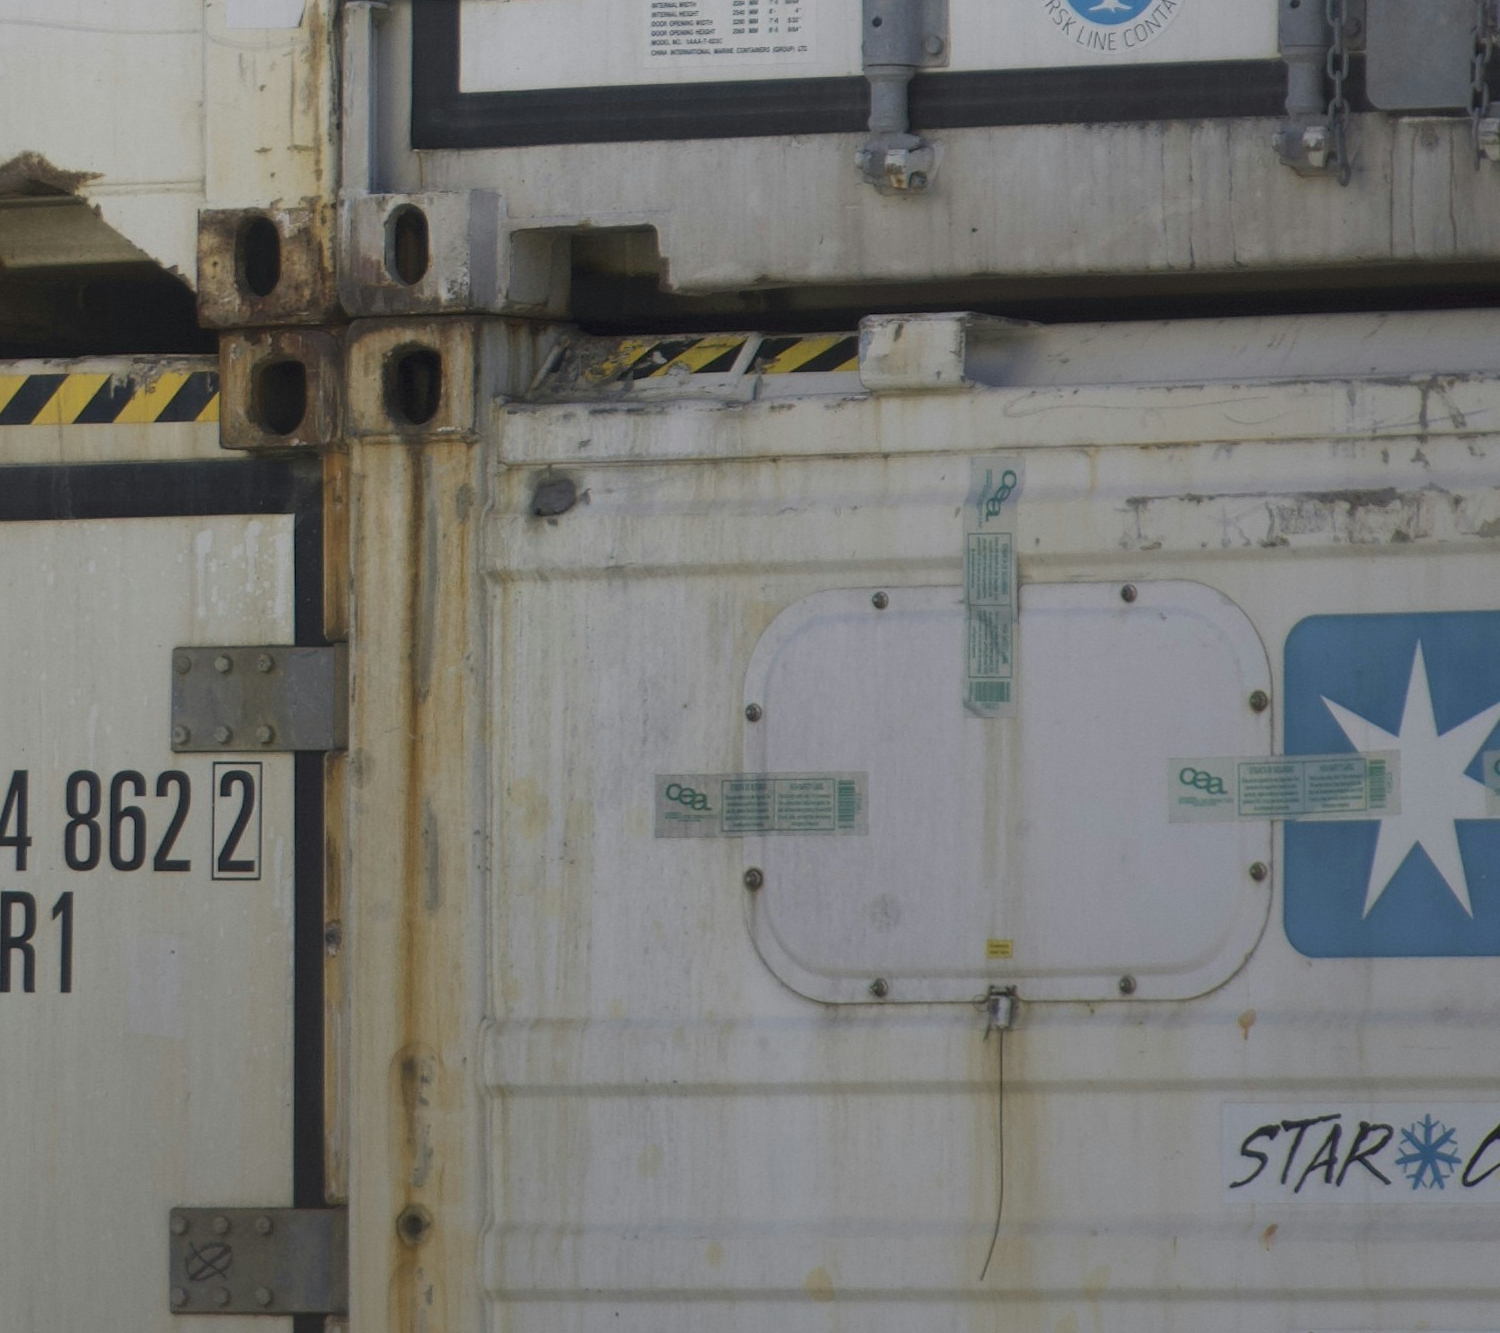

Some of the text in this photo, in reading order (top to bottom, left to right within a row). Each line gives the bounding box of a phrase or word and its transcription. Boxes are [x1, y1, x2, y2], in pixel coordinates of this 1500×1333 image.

[1076, 26, 1117, 51] LINE
[64, 767, 192, 873] 862
[219, 767, 258, 872] 2
[1230, 1111, 1396, 1195] STAR
